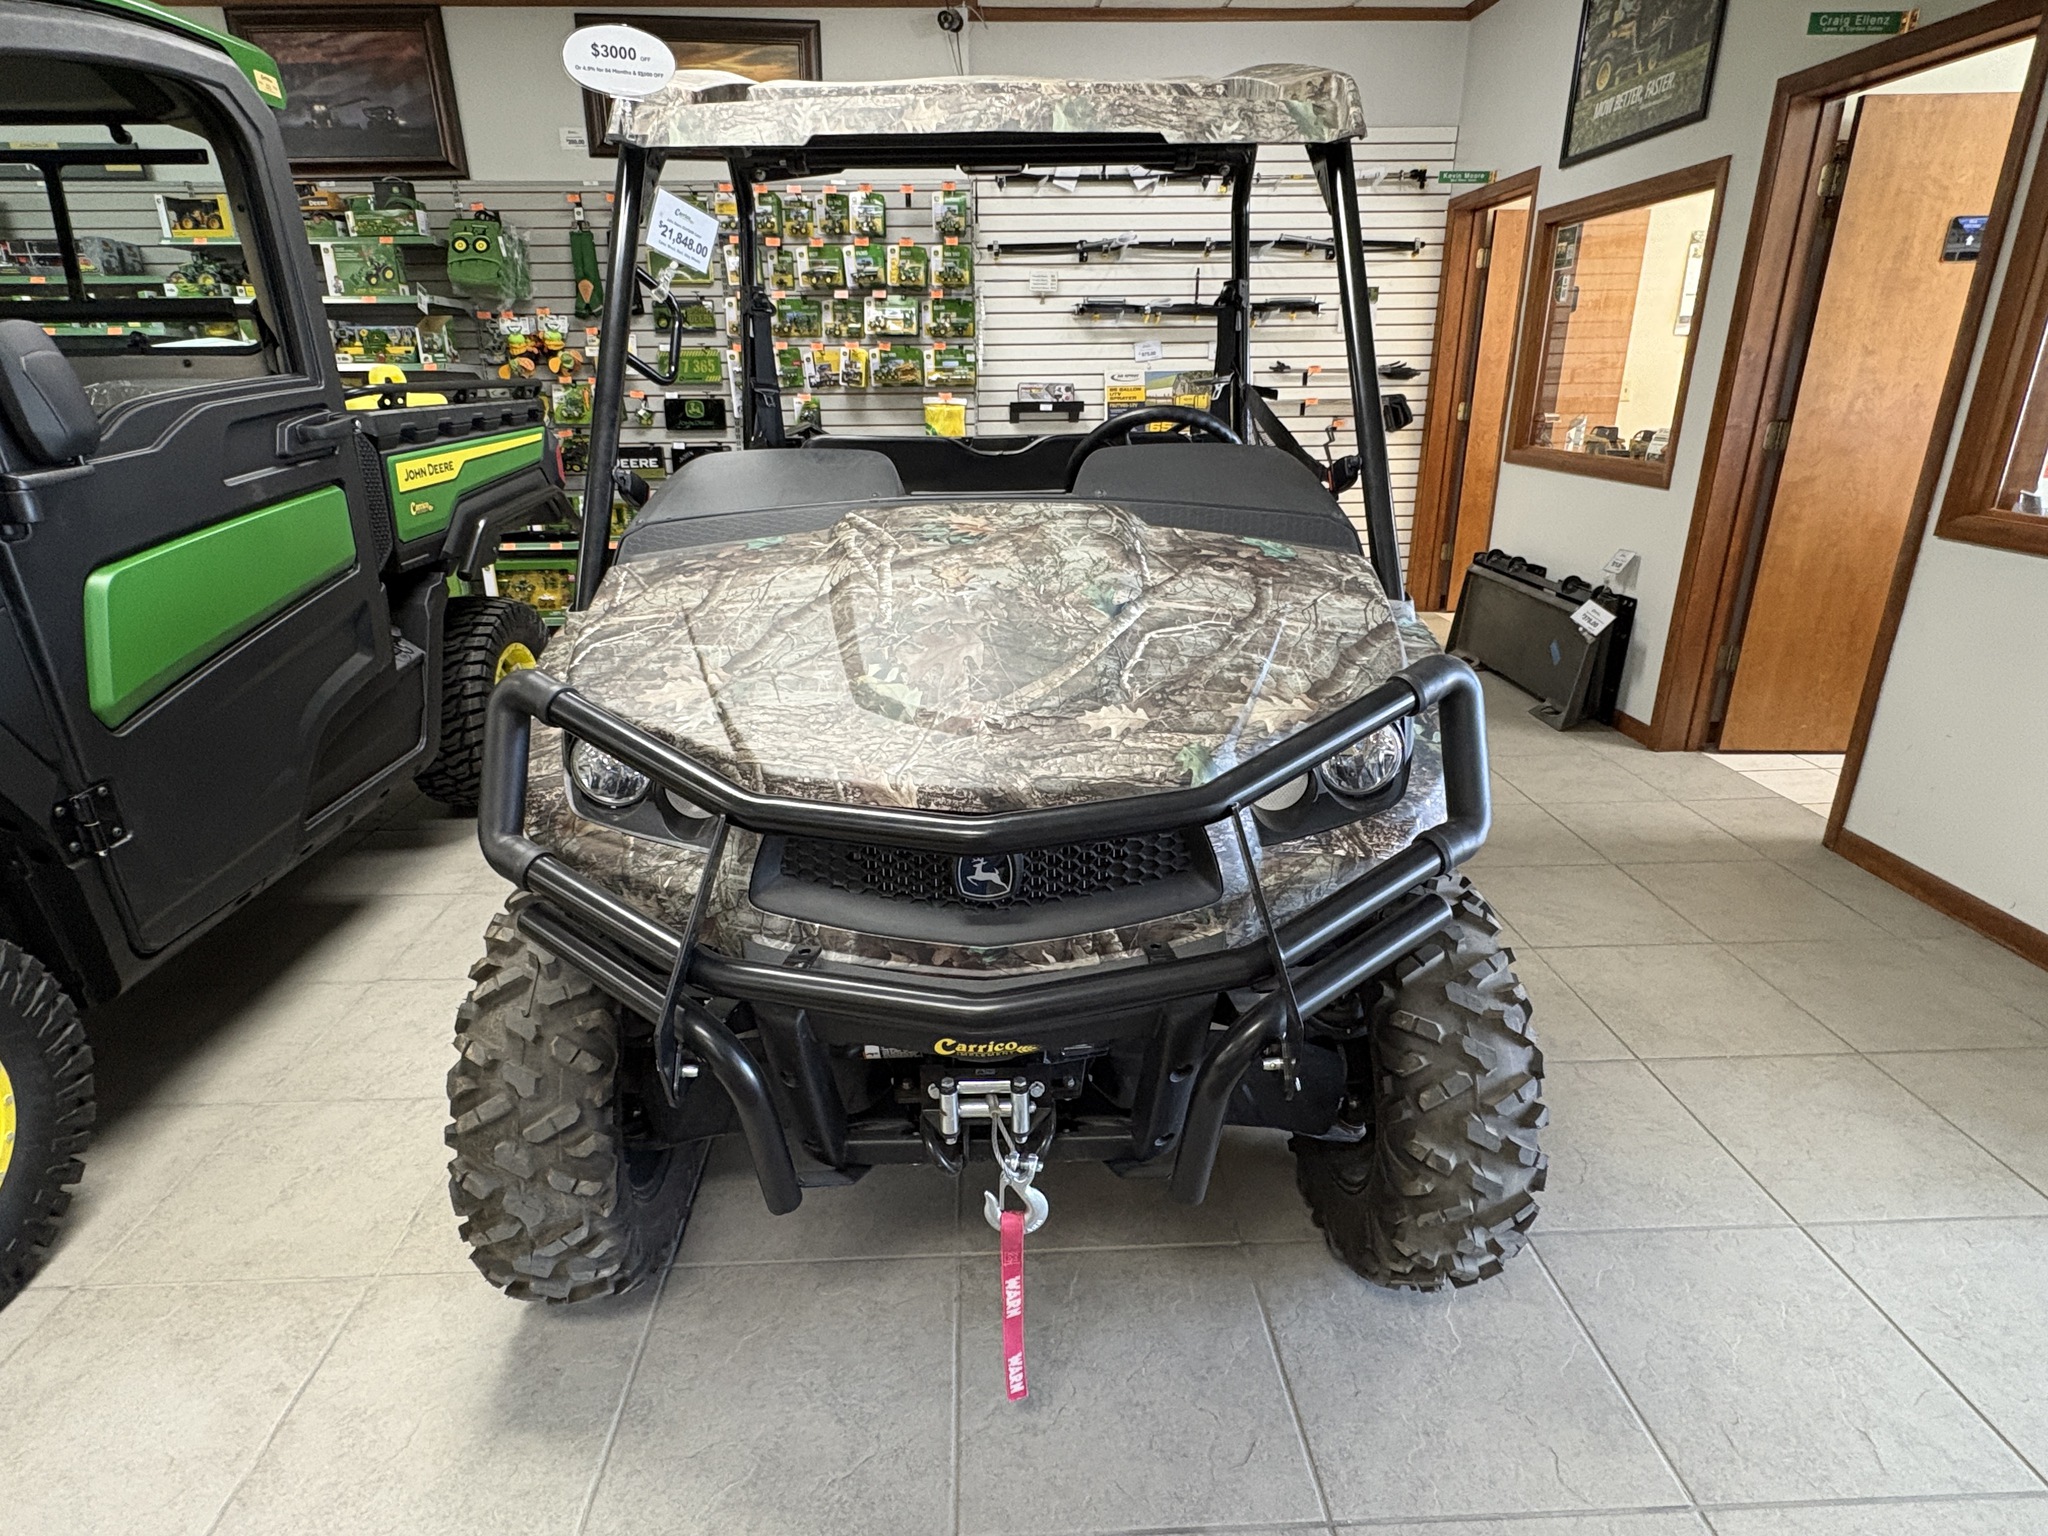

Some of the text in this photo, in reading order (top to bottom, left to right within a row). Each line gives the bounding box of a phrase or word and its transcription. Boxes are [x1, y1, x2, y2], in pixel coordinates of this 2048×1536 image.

[1820, 14, 1850, 28] Craig
[591, 42, 637, 61] $3000
[1593, 96, 1616, 119] MOW
[658, 220, 708, 258] $21,848.00
[694, 359, 715, 374] 365
[404, 461, 454, 482] JOHN DEERE
[934, 1038, 1018, 1056] Carrico
[1005, 1275, 1022, 1319] WARN
[1008, 1351, 1025, 1394] WARN
